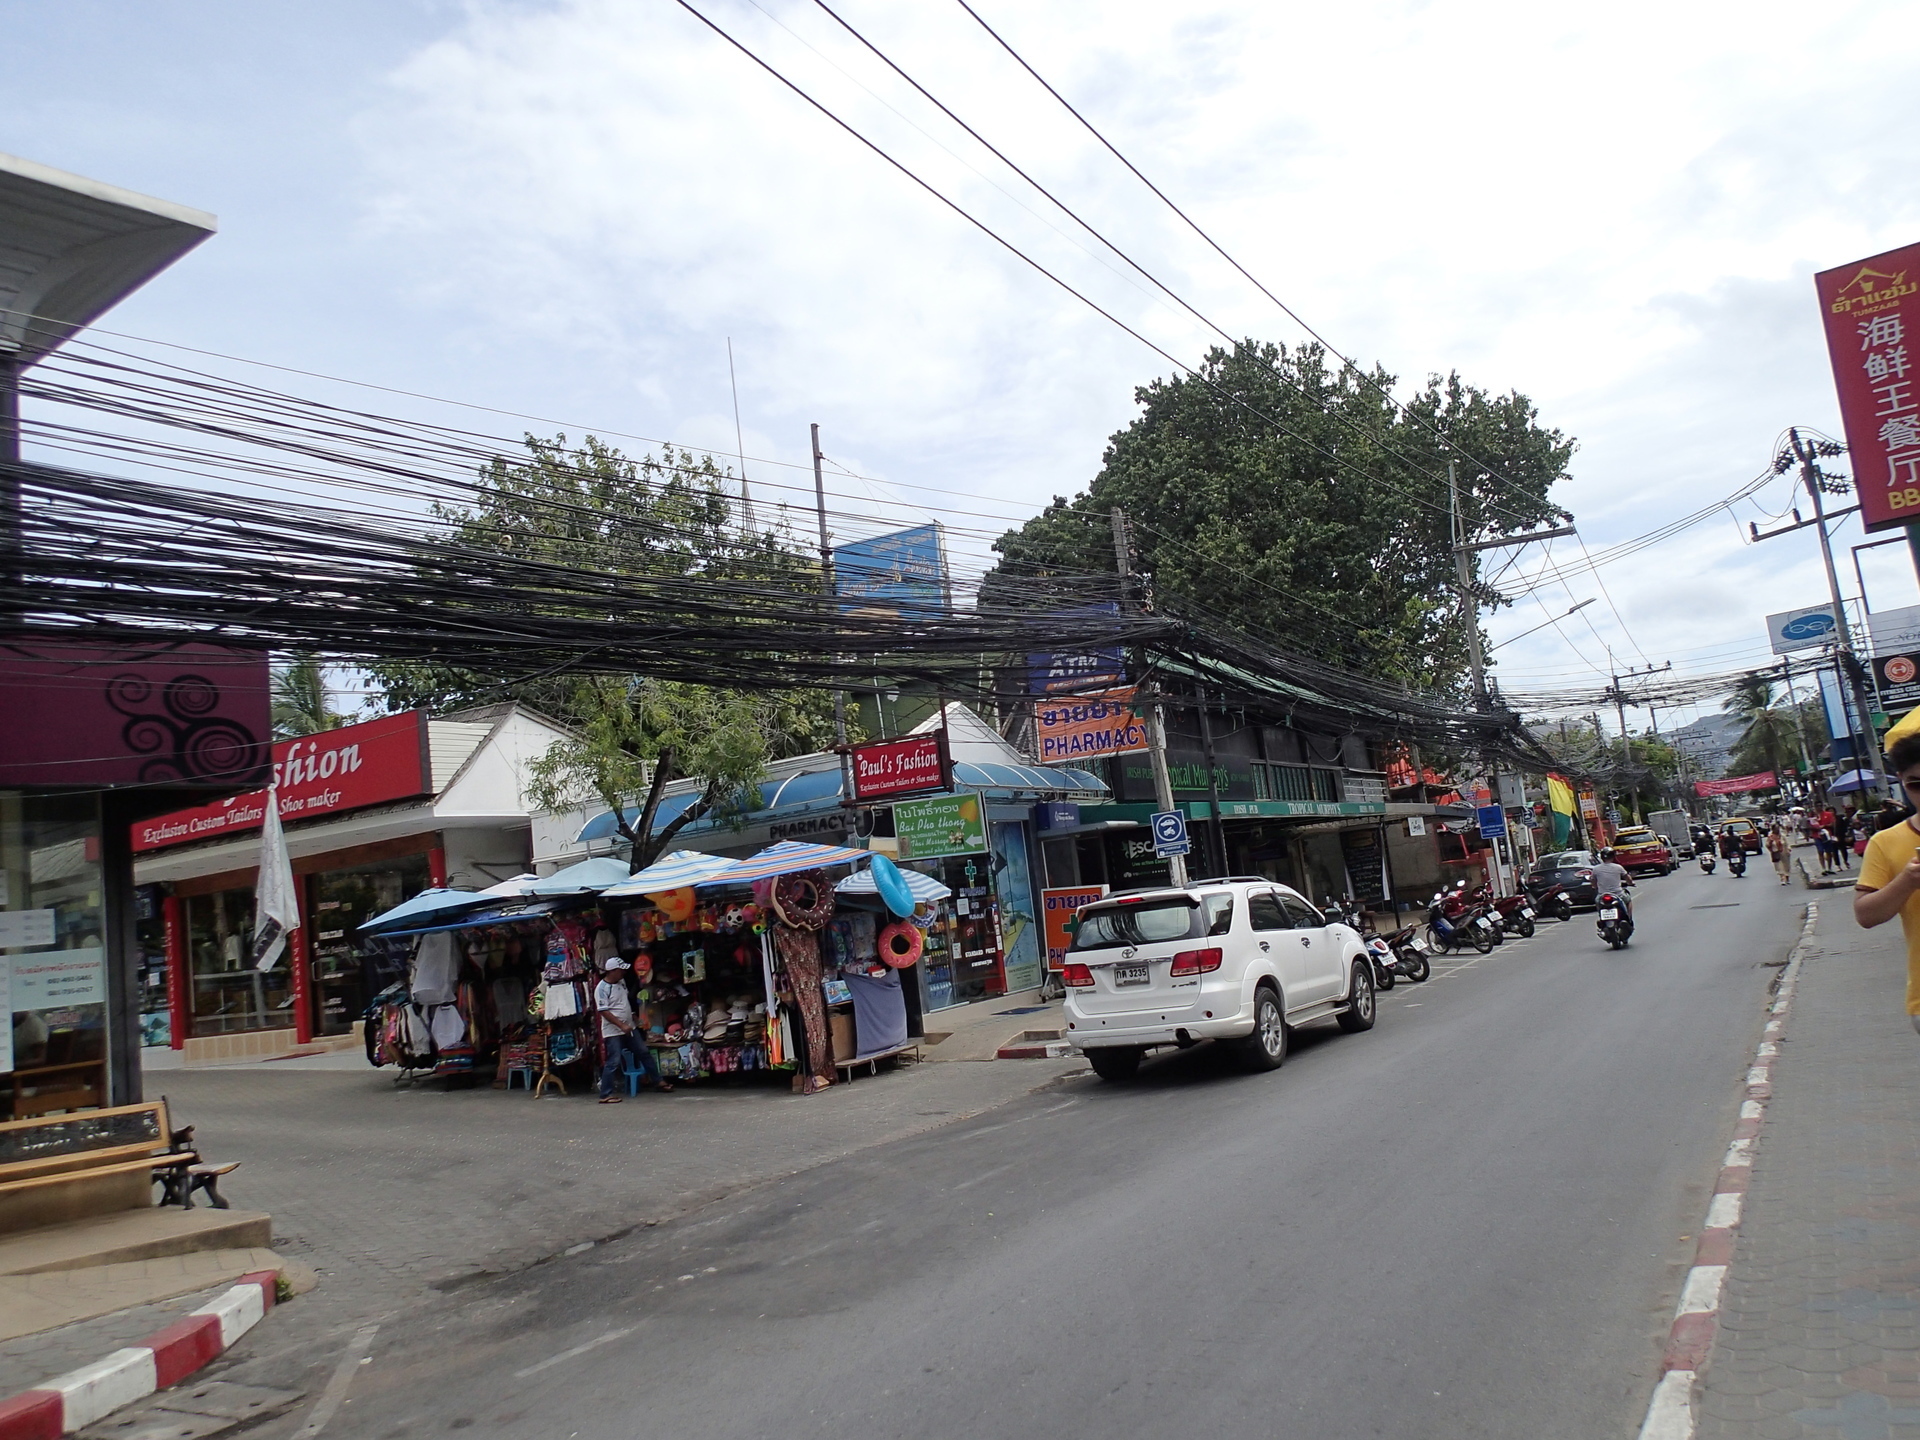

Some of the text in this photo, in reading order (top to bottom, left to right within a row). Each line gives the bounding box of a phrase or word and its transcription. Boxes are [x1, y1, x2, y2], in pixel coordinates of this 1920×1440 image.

[1852, 300, 1899, 317] TUMZAAB
[1857, 313, 1920, 487] 海鲜王餐厅
[860, 749, 938, 777] Paul's Fashion
[1127, 767, 1140, 778] IRISH
[1142, 767, 1153, 779] PUB
[143, 787, 341, 843] Exclusive Custom Tailors Shoe maker
[1249, 804, 1258, 814] PUB
[1288, 803, 1314, 814] TROPICAL
[1317, 803, 1341, 814] MURPHY'S
[769, 814, 846, 839] PHARMACY
[899, 816, 966, 832] Bai Pho thong
[911, 838, 949, 847] Thai Massage
[1047, 894, 1100, 910] ขายยา
[1129, 968, 1147, 978] 3235
